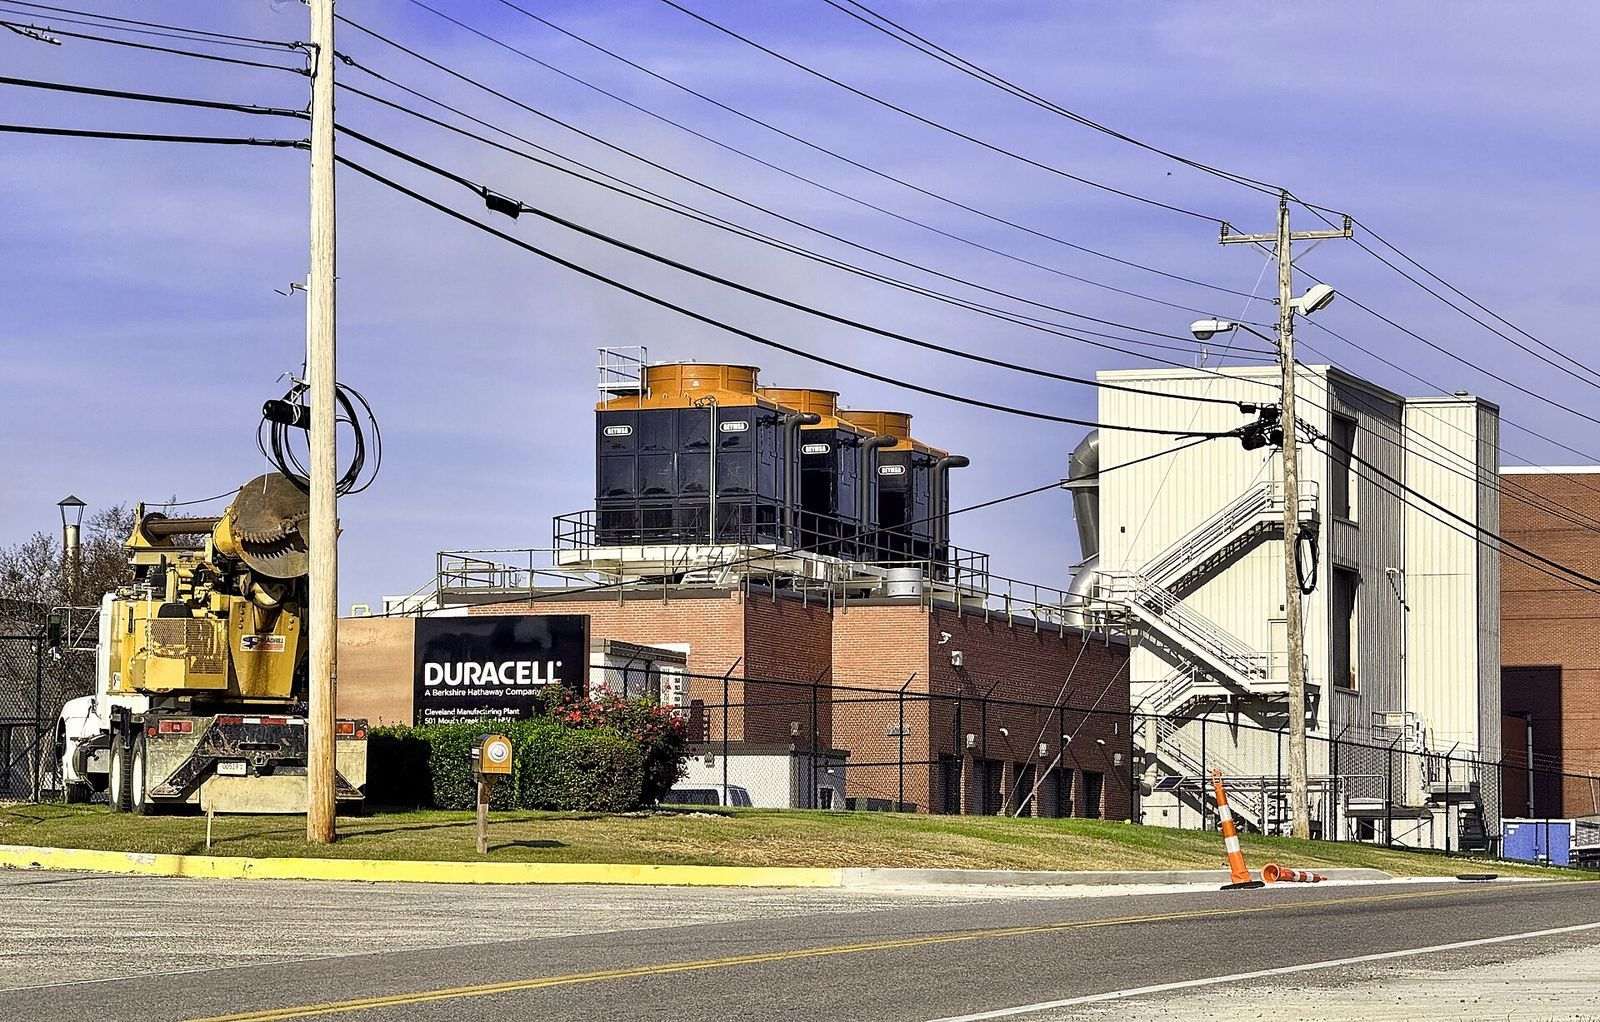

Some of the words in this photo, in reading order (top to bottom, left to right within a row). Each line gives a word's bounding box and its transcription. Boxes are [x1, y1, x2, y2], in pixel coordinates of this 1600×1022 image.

[424, 689, 431, 697] A
[432, 688, 466, 697] Berkshire
[467, 687, 504, 697] Hathaway
[505, 687, 542, 697] Company
[424, 708, 456, 716] Cleveland
[503, 707, 520, 715] Plant
